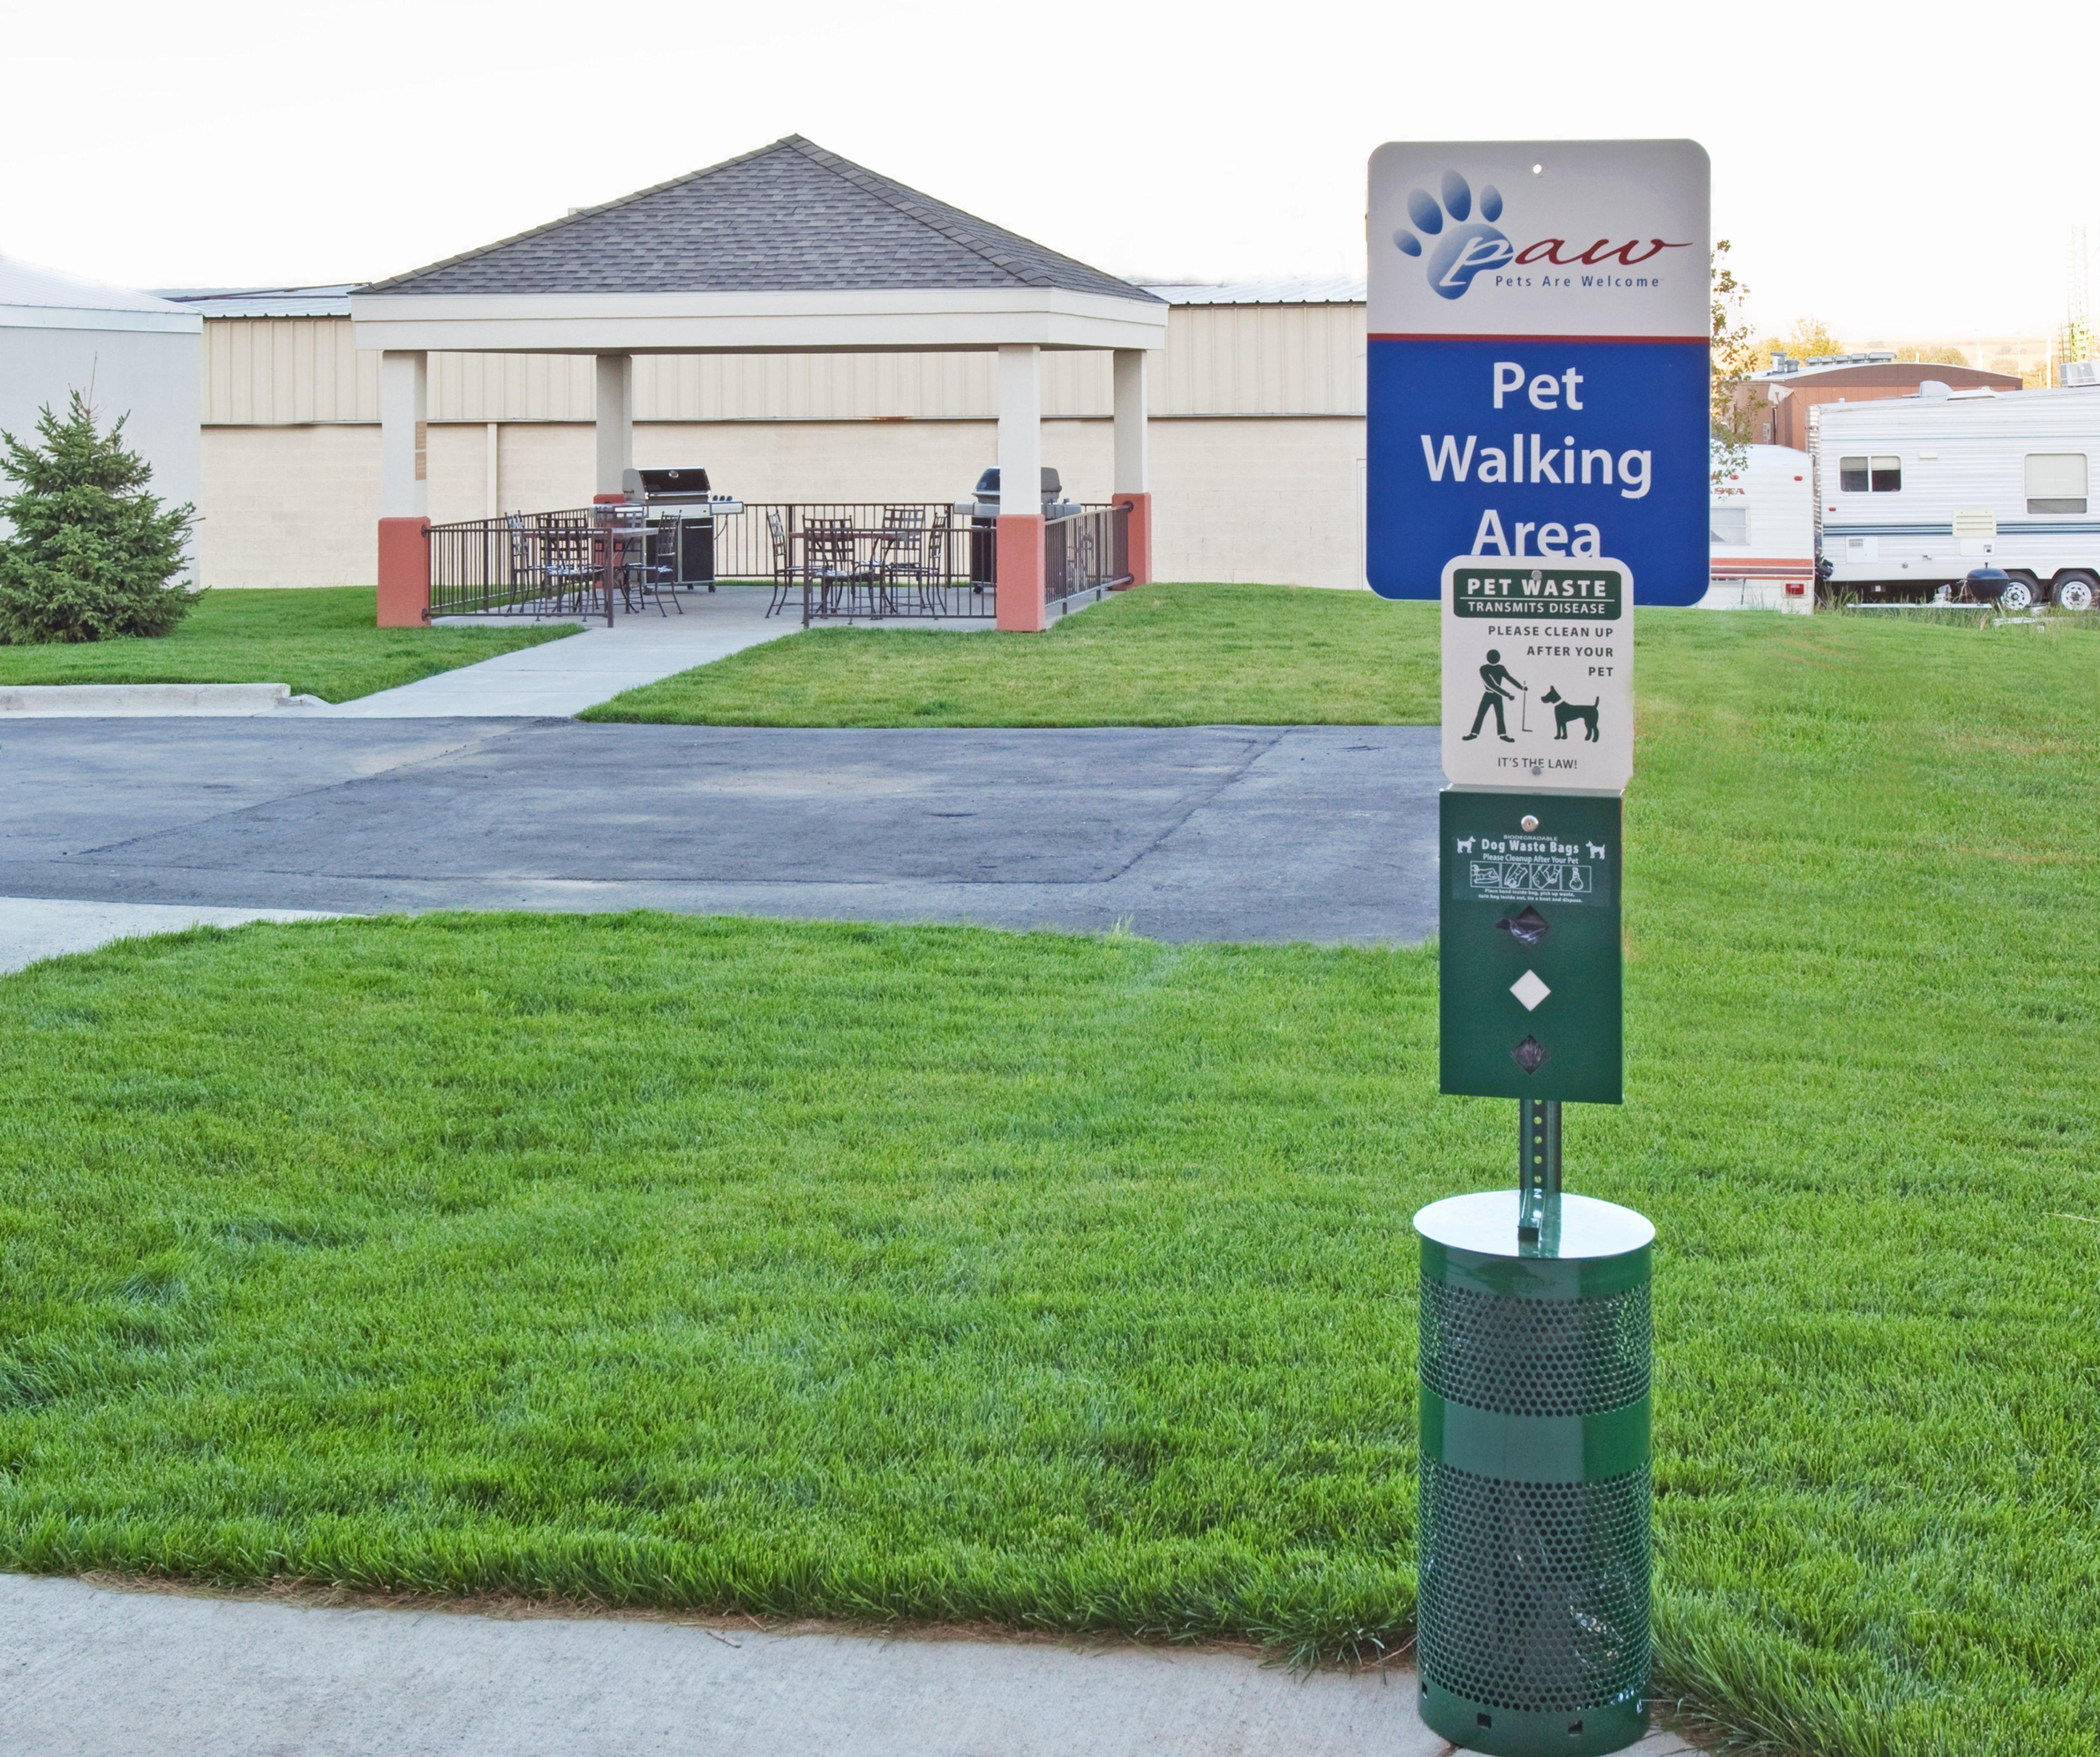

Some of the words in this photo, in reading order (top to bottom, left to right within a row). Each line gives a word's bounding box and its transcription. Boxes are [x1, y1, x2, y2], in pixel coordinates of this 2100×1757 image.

[1440, 236, 1693, 286] paw
[1496, 276, 1532, 287] Pets
[1542, 276, 1571, 287] Are
[1581, 275, 1659, 287] Welcome
[1493, 362, 1584, 411] Pet
[1421, 433, 1652, 499] Walking
[1470, 509, 1601, 558] Area
[1467, 578, 1512, 596] PET
[1521, 579, 1606, 597] WASTE
[1468, 601, 1544, 613] TRANSMITS
[1549, 603, 1605, 614] DISEASE
[1488, 626, 1539, 636] PLEASE
[1545, 627, 1589, 637] CLEAN
[1595, 628, 1613, 637] UP
[1526, 646, 1570, 656] AFTER
[1575, 647, 1613, 657] YOUR
[1589, 667, 1613, 676] PET
[1498, 757, 1519, 767] IT'S
[1522, 758, 1544, 768] THE
[1548, 759, 1577, 769] LAW!
[1481, 839, 1505, 853] Dog
[1509, 840, 1546, 852] Waste
[1550, 842, 1579, 856] Bags
[1505, 854, 1532, 863] Cleanup
